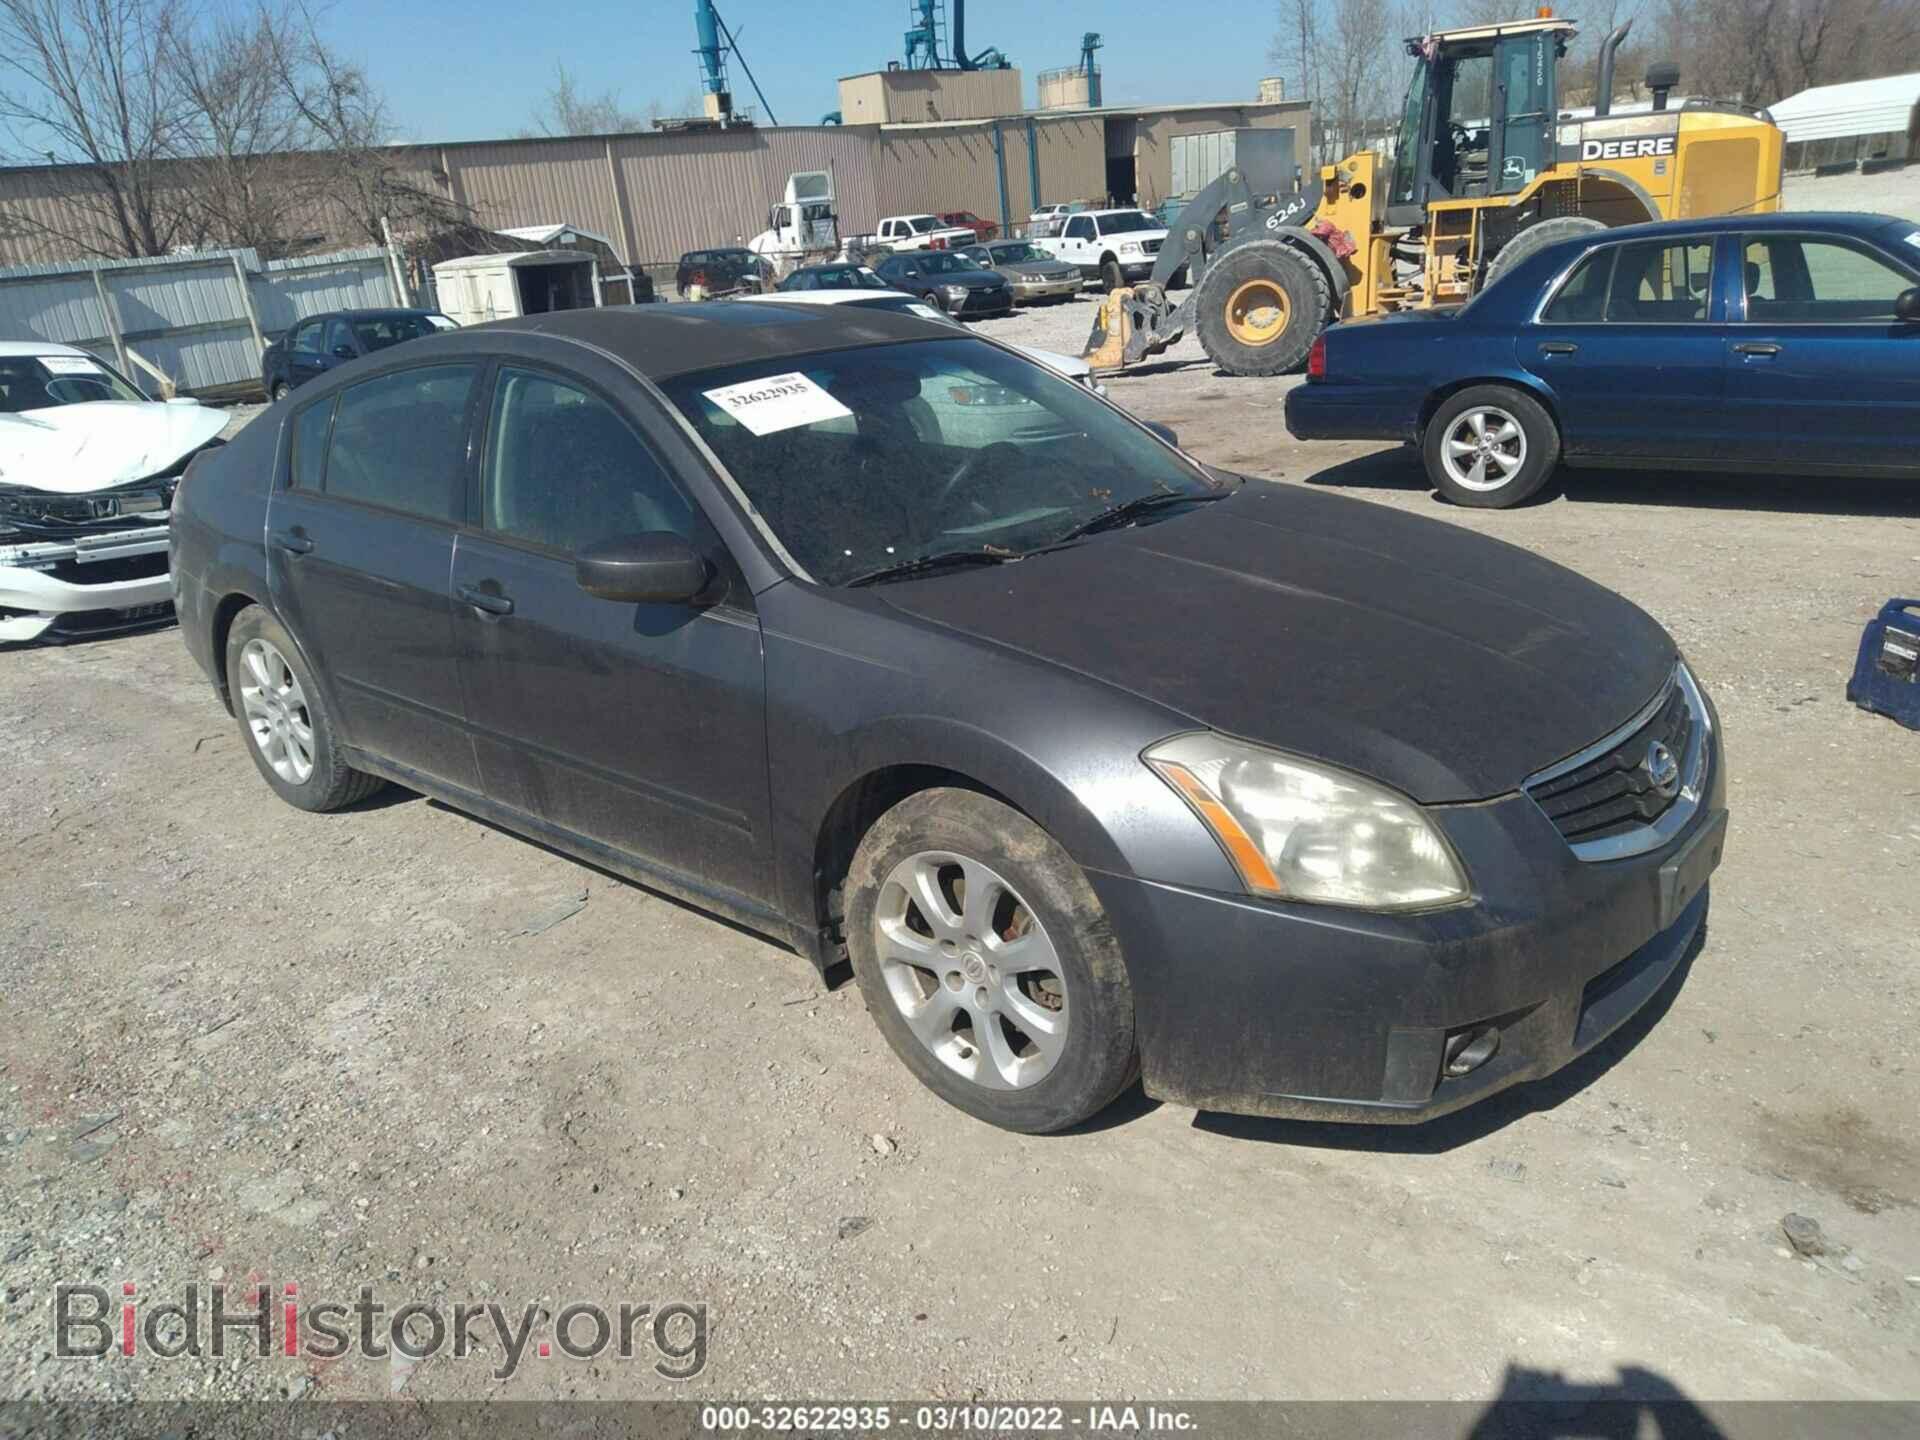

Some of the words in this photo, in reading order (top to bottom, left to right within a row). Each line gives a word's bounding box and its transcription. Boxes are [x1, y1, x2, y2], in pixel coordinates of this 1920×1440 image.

[1583, 137, 1674, 161] DEERE
[1266, 197, 1306, 229] 624J
[728, 382, 809, 408] 32622935
